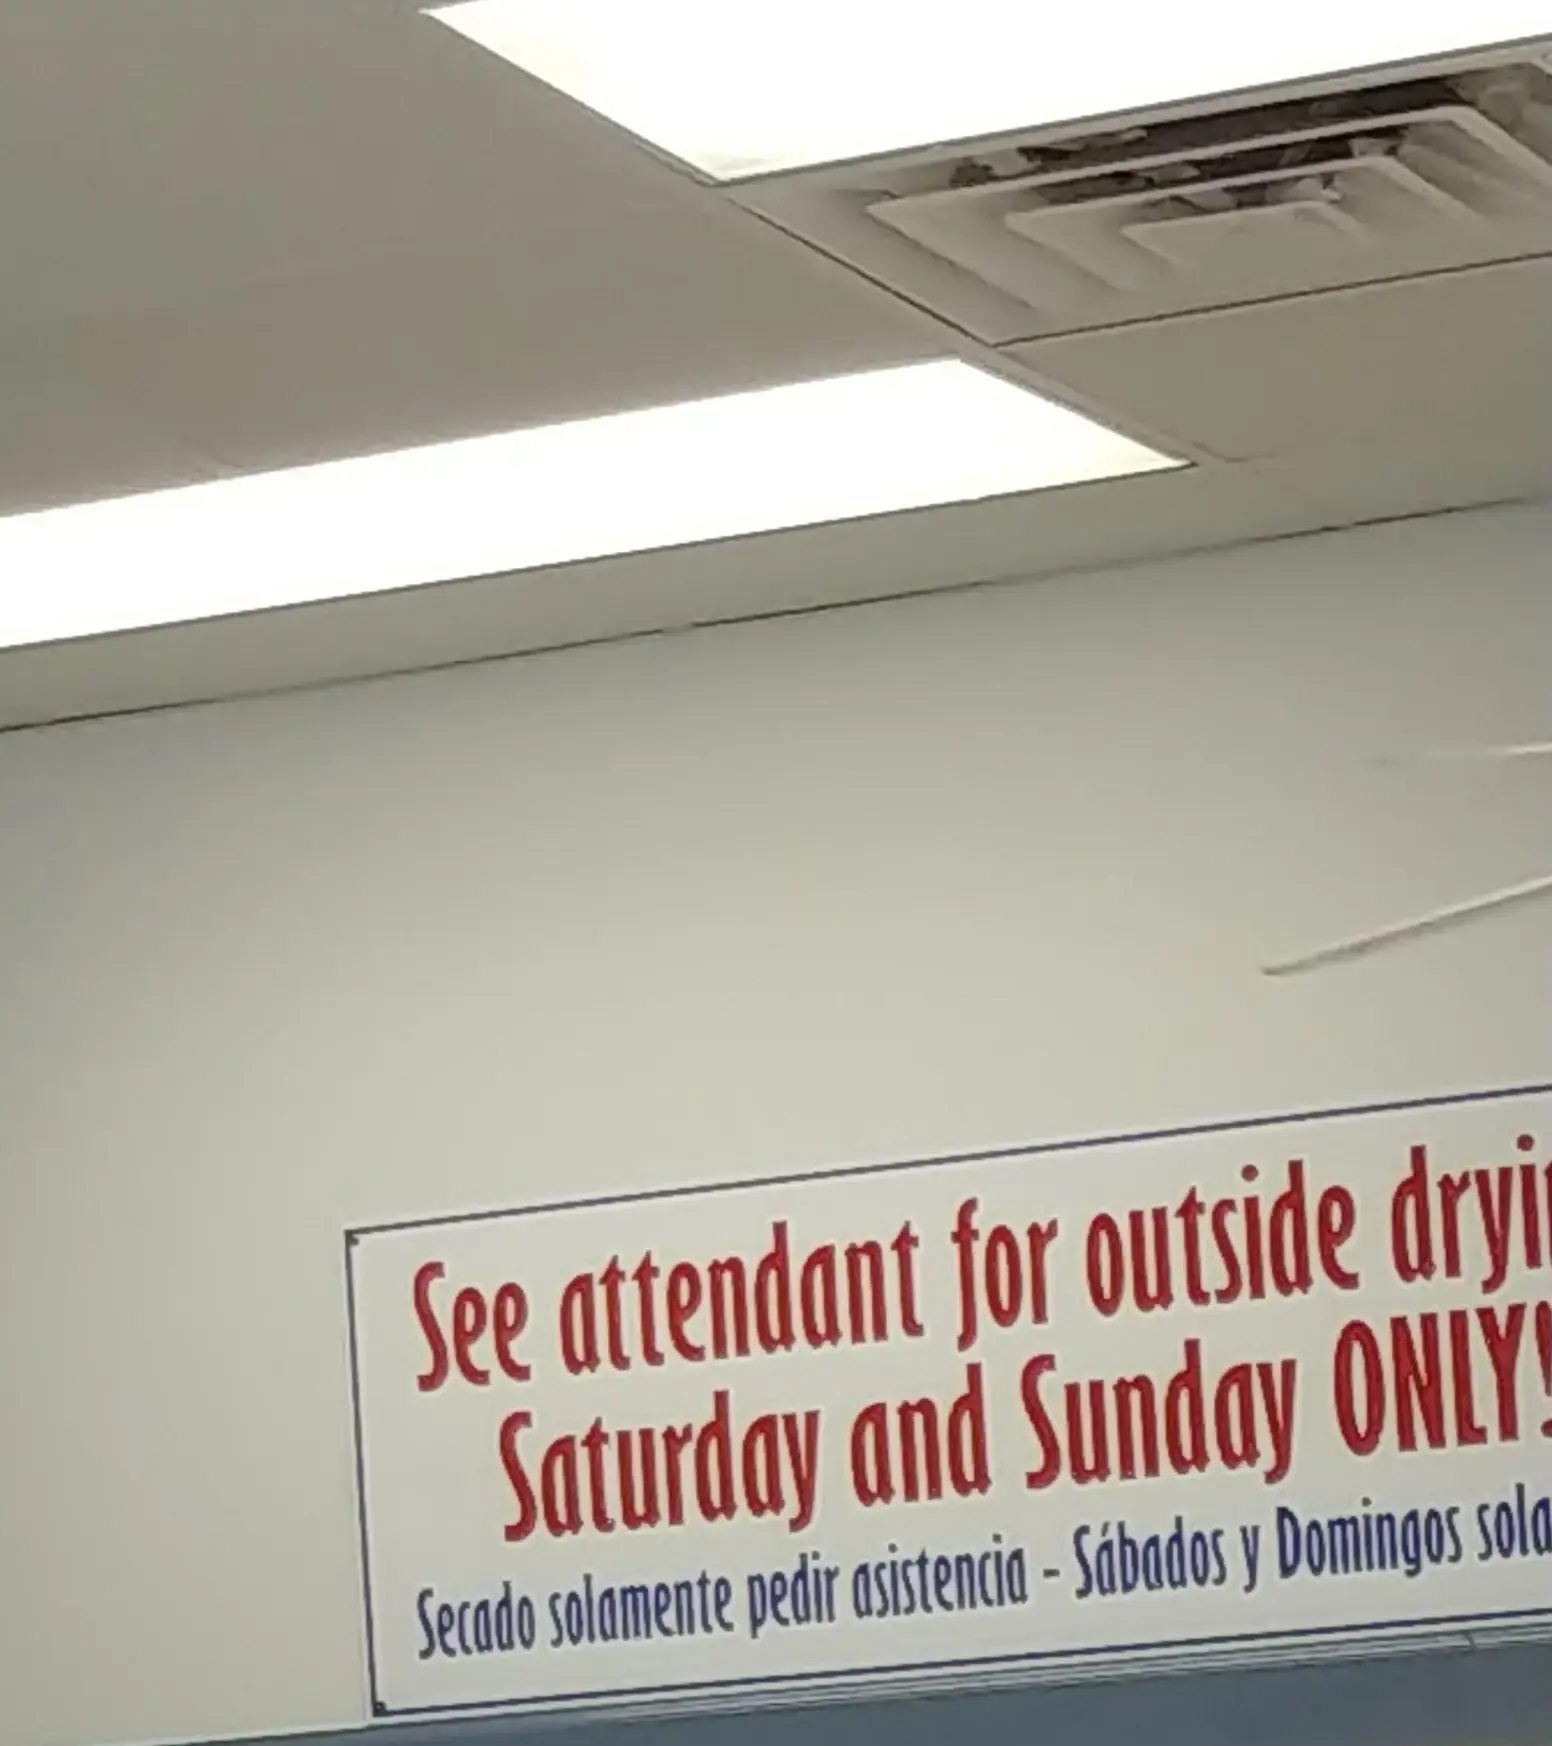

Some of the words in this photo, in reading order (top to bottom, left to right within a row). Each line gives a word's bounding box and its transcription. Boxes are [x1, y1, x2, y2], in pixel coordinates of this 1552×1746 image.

[412, 1260, 532, 1392] See
[559, 1220, 924, 1374] attendant
[952, 1197, 1059, 1352] for
[1086, 1161, 1359, 1314] outside
[499, 1389, 820, 1541] Saturday
[850, 1361, 992, 1506] and
[1021, 1337, 1296, 1490] Sunday
[1332, 1301, 1552, 1456] ONLY!
[416, 1579, 537, 1661] Secado
[547, 1569, 735, 1649] solamente
[746, 1549, 840, 1640] pedir
[851, 1532, 1029, 1620] asistencia
[1072, 1513, 1228, 1600] Sábados
[1239, 1523, 1262, 1594] y
[1276, 1497, 1464, 1580] Domingos
